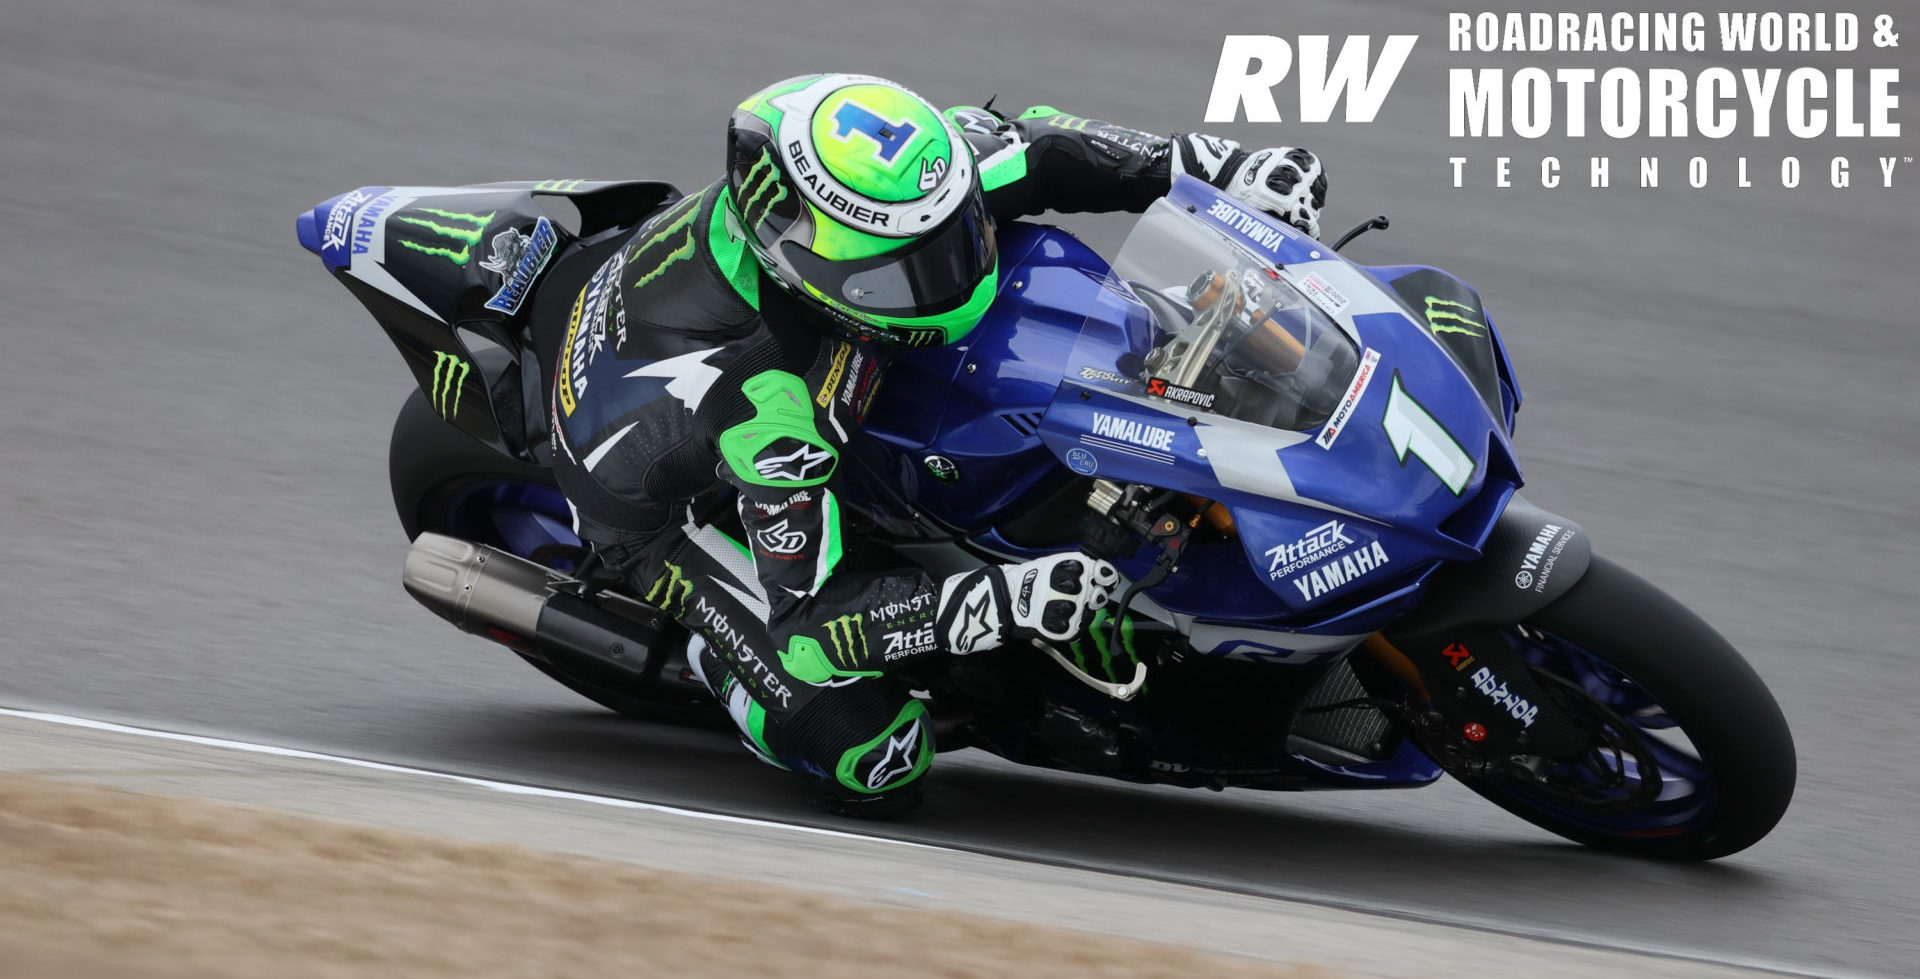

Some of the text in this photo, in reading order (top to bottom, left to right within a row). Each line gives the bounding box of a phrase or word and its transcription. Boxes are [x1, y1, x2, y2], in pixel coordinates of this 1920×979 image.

[829, 98, 920, 168] 1
[788, 139, 890, 228] BEAUBIER
[351, 194, 396, 255] YAMAHA
[1206, 199, 1285, 254] YAMALUBE
[487, 218, 554, 311] BEAUBIER
[572, 279, 604, 400] YAMAHA
[840, 348, 864, 407] YAMALUBE
[1333, 364, 1371, 429] MOTOAMERICA
[1091, 412, 1176, 452] YAMALUBE
[1382, 368, 1476, 497] 1
[1264, 519, 1355, 573] Attack
[1269, 540, 1347, 582] PERFORMANCE
[1292, 540, 1390, 602] YAMAHA
[1520, 523, 1563, 571] YAMAHA
[1534, 528, 1576, 594] FINANCIAL SERVICES
[695, 596, 793, 709] MONSTER
